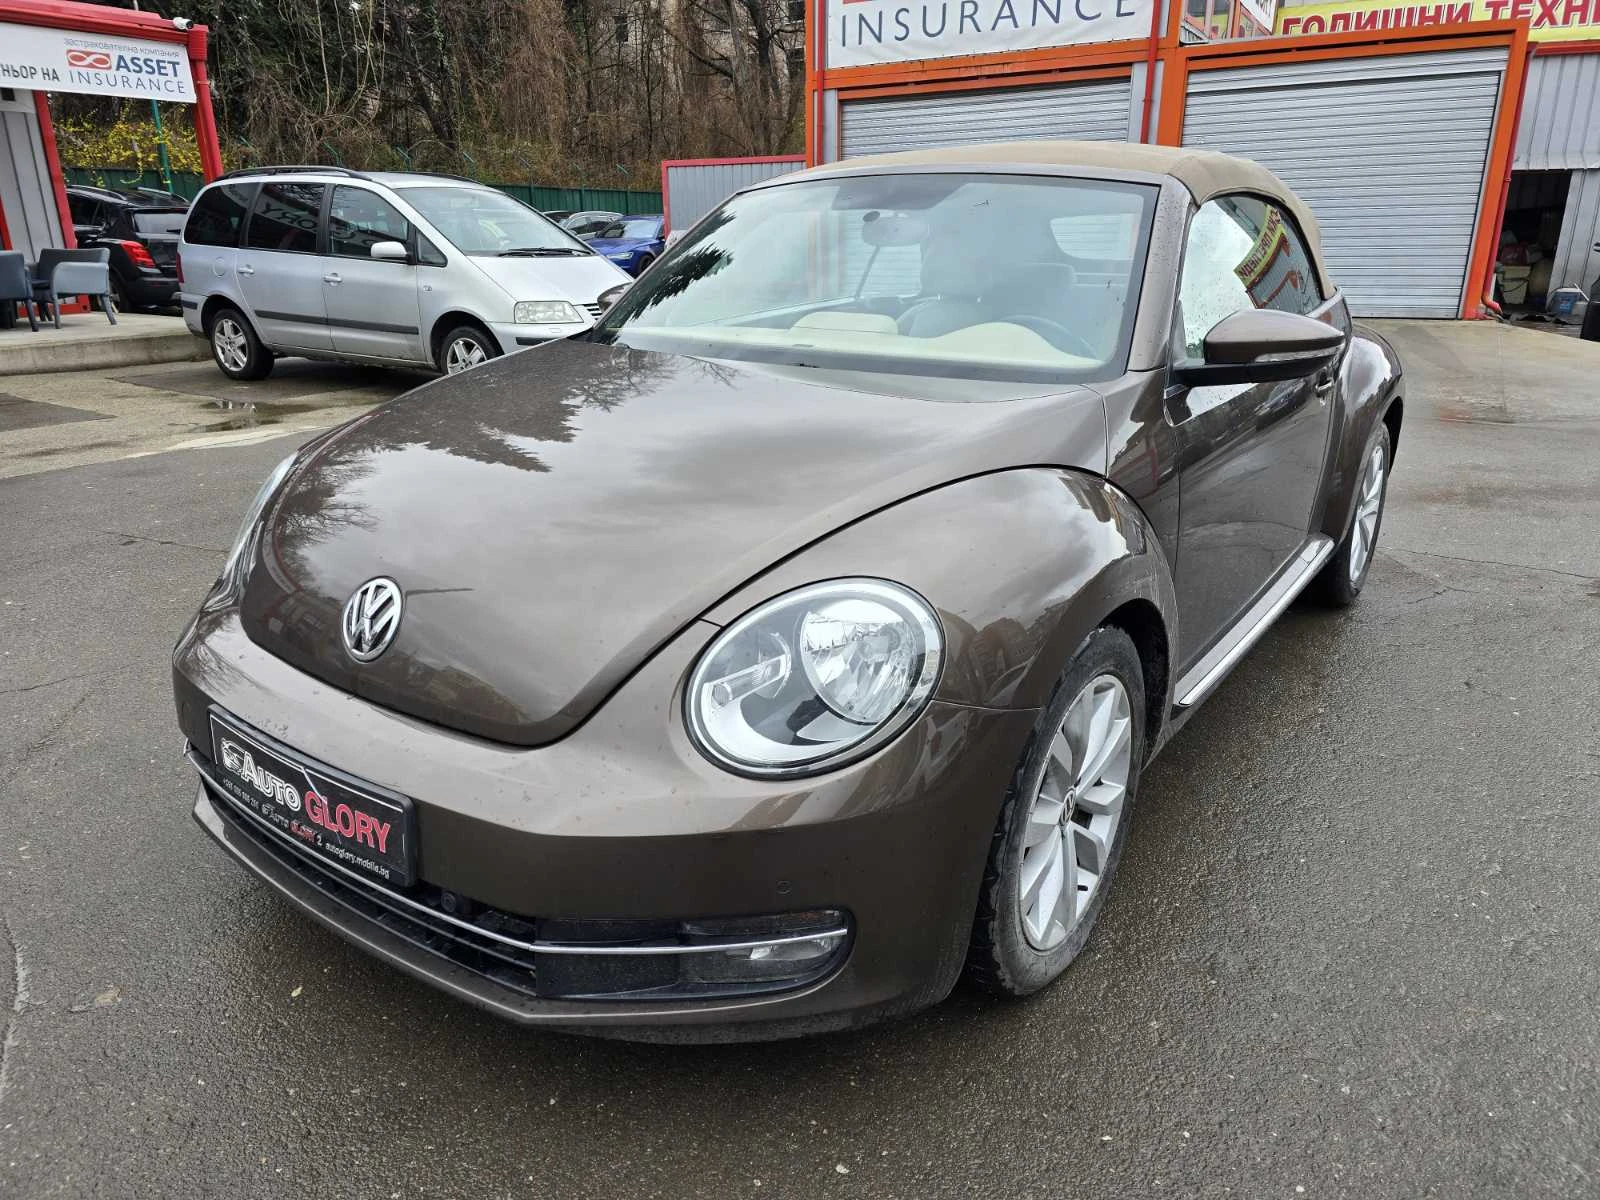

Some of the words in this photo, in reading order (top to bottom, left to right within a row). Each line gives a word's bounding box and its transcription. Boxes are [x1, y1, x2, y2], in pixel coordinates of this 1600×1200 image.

[1485, 0, 1600, 27] ТЕХН
[41, 67, 60, 82] НА
[115, 54, 180, 77] ASSET
[69, 70, 186, 94] INSURANCE
[304, 790, 391, 854] GLORY
